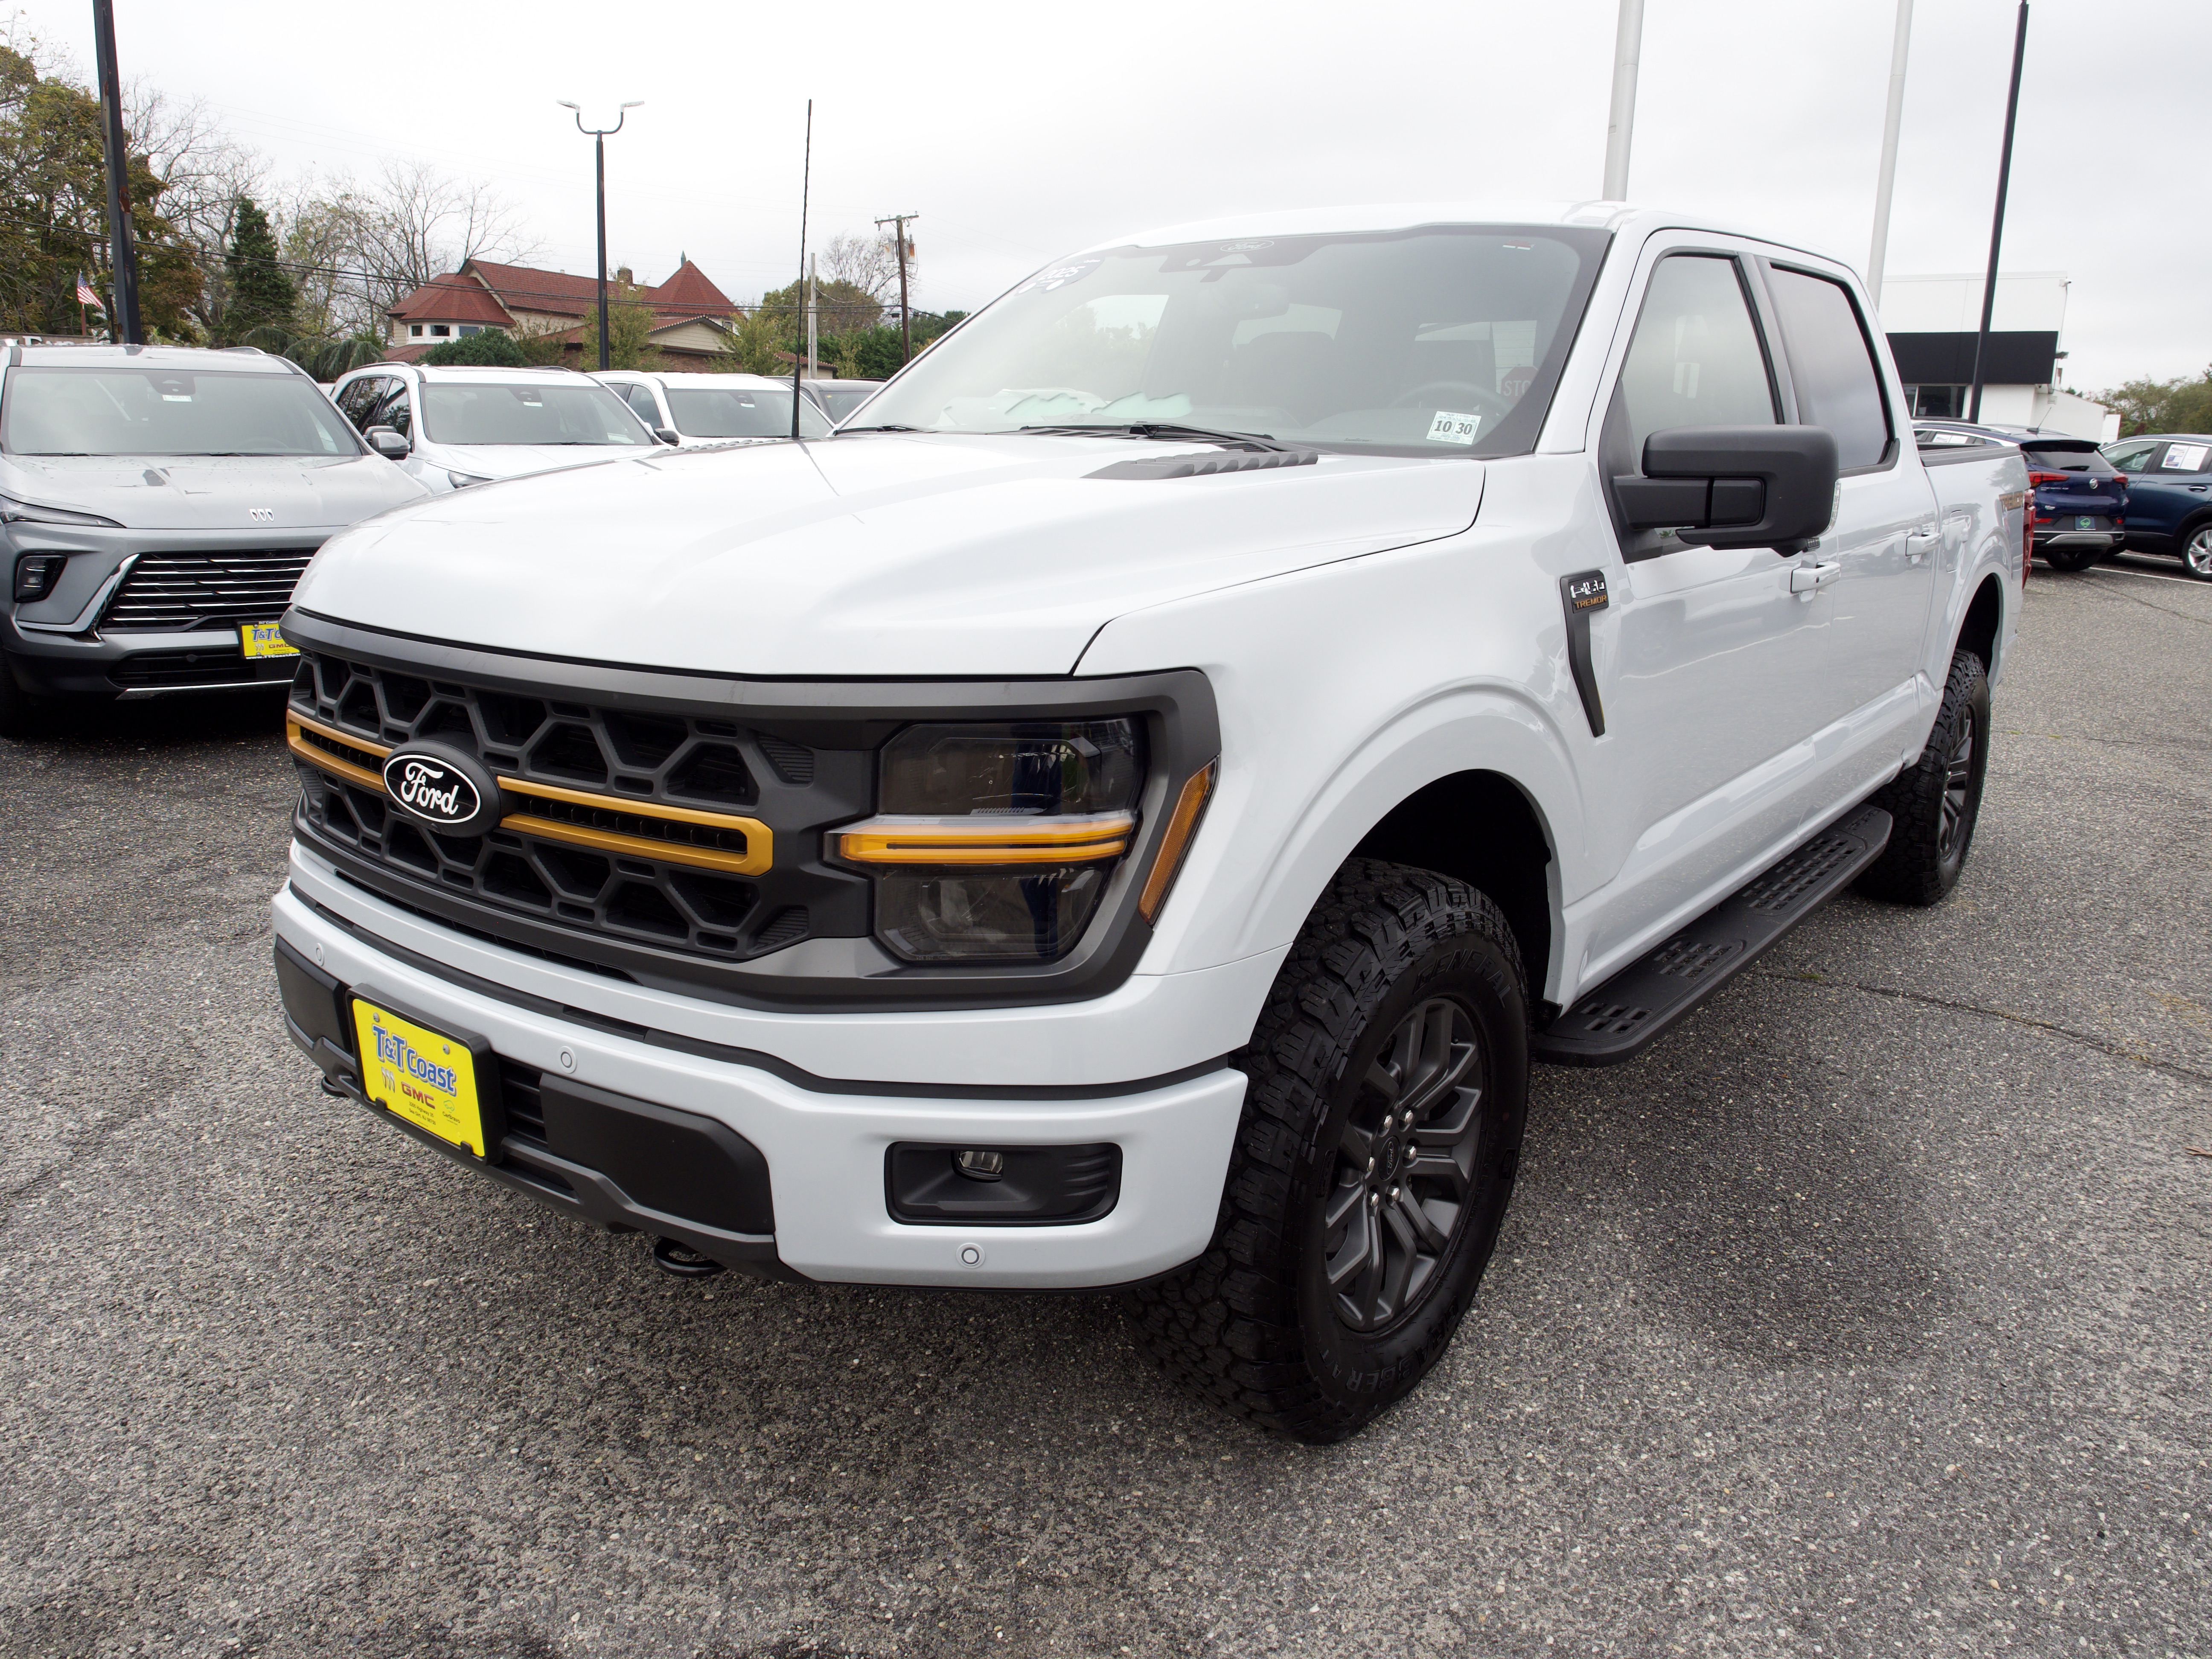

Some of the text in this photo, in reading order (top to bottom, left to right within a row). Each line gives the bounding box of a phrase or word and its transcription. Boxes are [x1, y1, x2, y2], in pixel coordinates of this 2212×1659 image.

[1227, 242, 1266, 251] Ford
[1037, 266, 1086, 281] 2025
[1503, 380, 1532, 397] STO
[1434, 420, 1473, 435] 10 30
[1570, 580, 1605, 598] F-150
[1575, 595, 1607, 609] TREMOR
[251, 628, 275, 642] T&T
[401, 762, 459, 815] Ford
[1412, 948, 1512, 1010] GENERAL
[372, 1024, 457, 1097] T&T Coast
[401, 1082, 436, 1109] GMC
[417, 1106, 429, 1116] Highway
[1346, 1295, 1459, 1394] GRABBER
